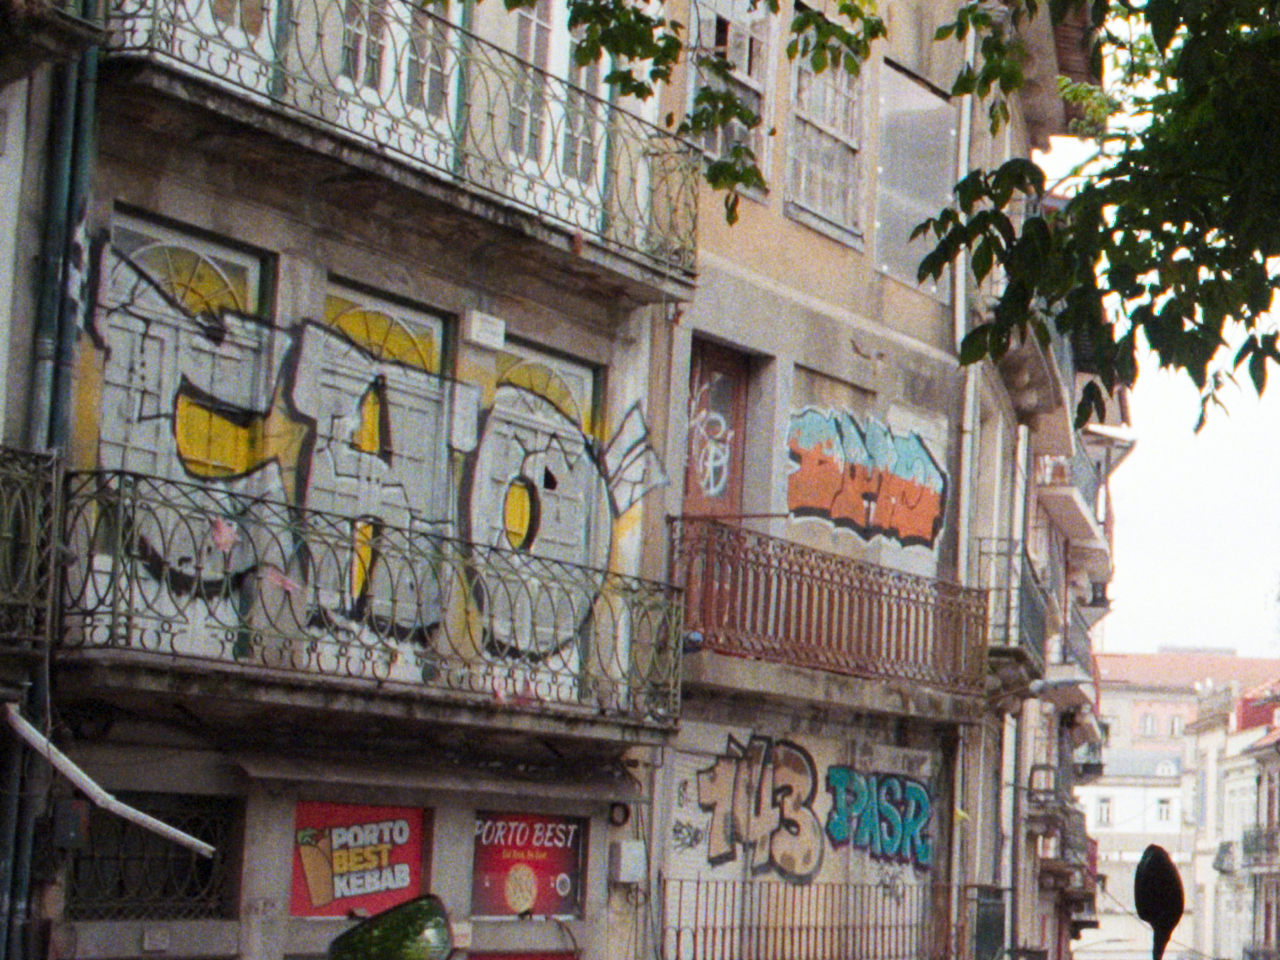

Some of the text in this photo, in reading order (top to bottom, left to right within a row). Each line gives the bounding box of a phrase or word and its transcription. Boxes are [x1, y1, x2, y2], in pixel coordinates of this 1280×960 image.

[331, 820, 410, 849] PORTO
[532, 822, 578, 848] BEST
[333, 843, 392, 874] BEST
[333, 863, 411, 898] KEBAB
